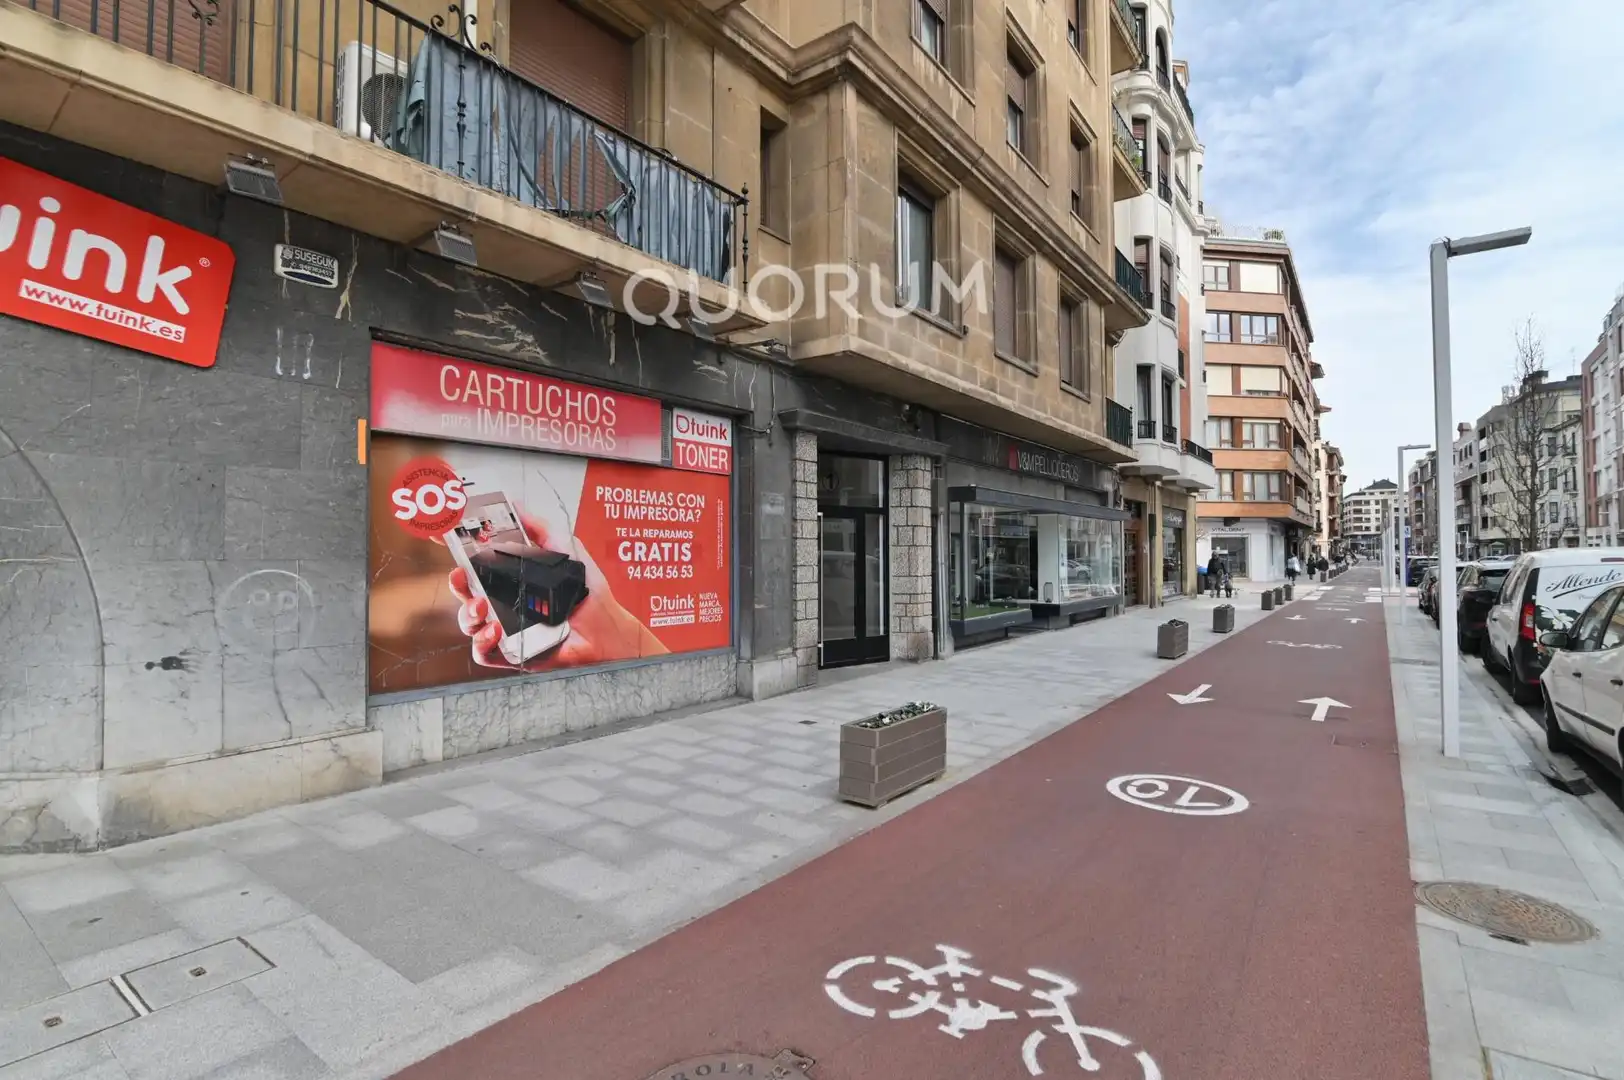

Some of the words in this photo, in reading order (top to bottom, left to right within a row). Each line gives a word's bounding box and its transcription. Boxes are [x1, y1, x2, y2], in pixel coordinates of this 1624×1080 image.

[24, 284, 184, 341] www.tuink.es
[440, 364, 617, 427] CARTUCHOS
[440, 412, 472, 428] para
[477, 408, 617, 451] IMPRESORAS
[675, 441, 729, 471] TONER
[403, 468, 448, 488] ASISTENCIA
[391, 479, 467, 520] SOS
[596, 485, 673, 506] PROBLEMAS
[677, 493, 705, 508] CON
[409, 510, 458, 531] IMPRESORAS
[604, 503, 620, 519] TU
[623, 504, 702, 522] IMPRESORA?
[616, 527, 627, 537] TE
[629, 528, 641, 537] LA
[642, 528, 693, 539] REPARAMOS
[627, 566, 641, 580] 94
[643, 565, 664, 579] 434
[666, 565, 679, 578] 56
[680, 564, 693, 578] 53
[1545, 569, 1621, 592] Allende
[699, 592, 718, 600] NUEVA
